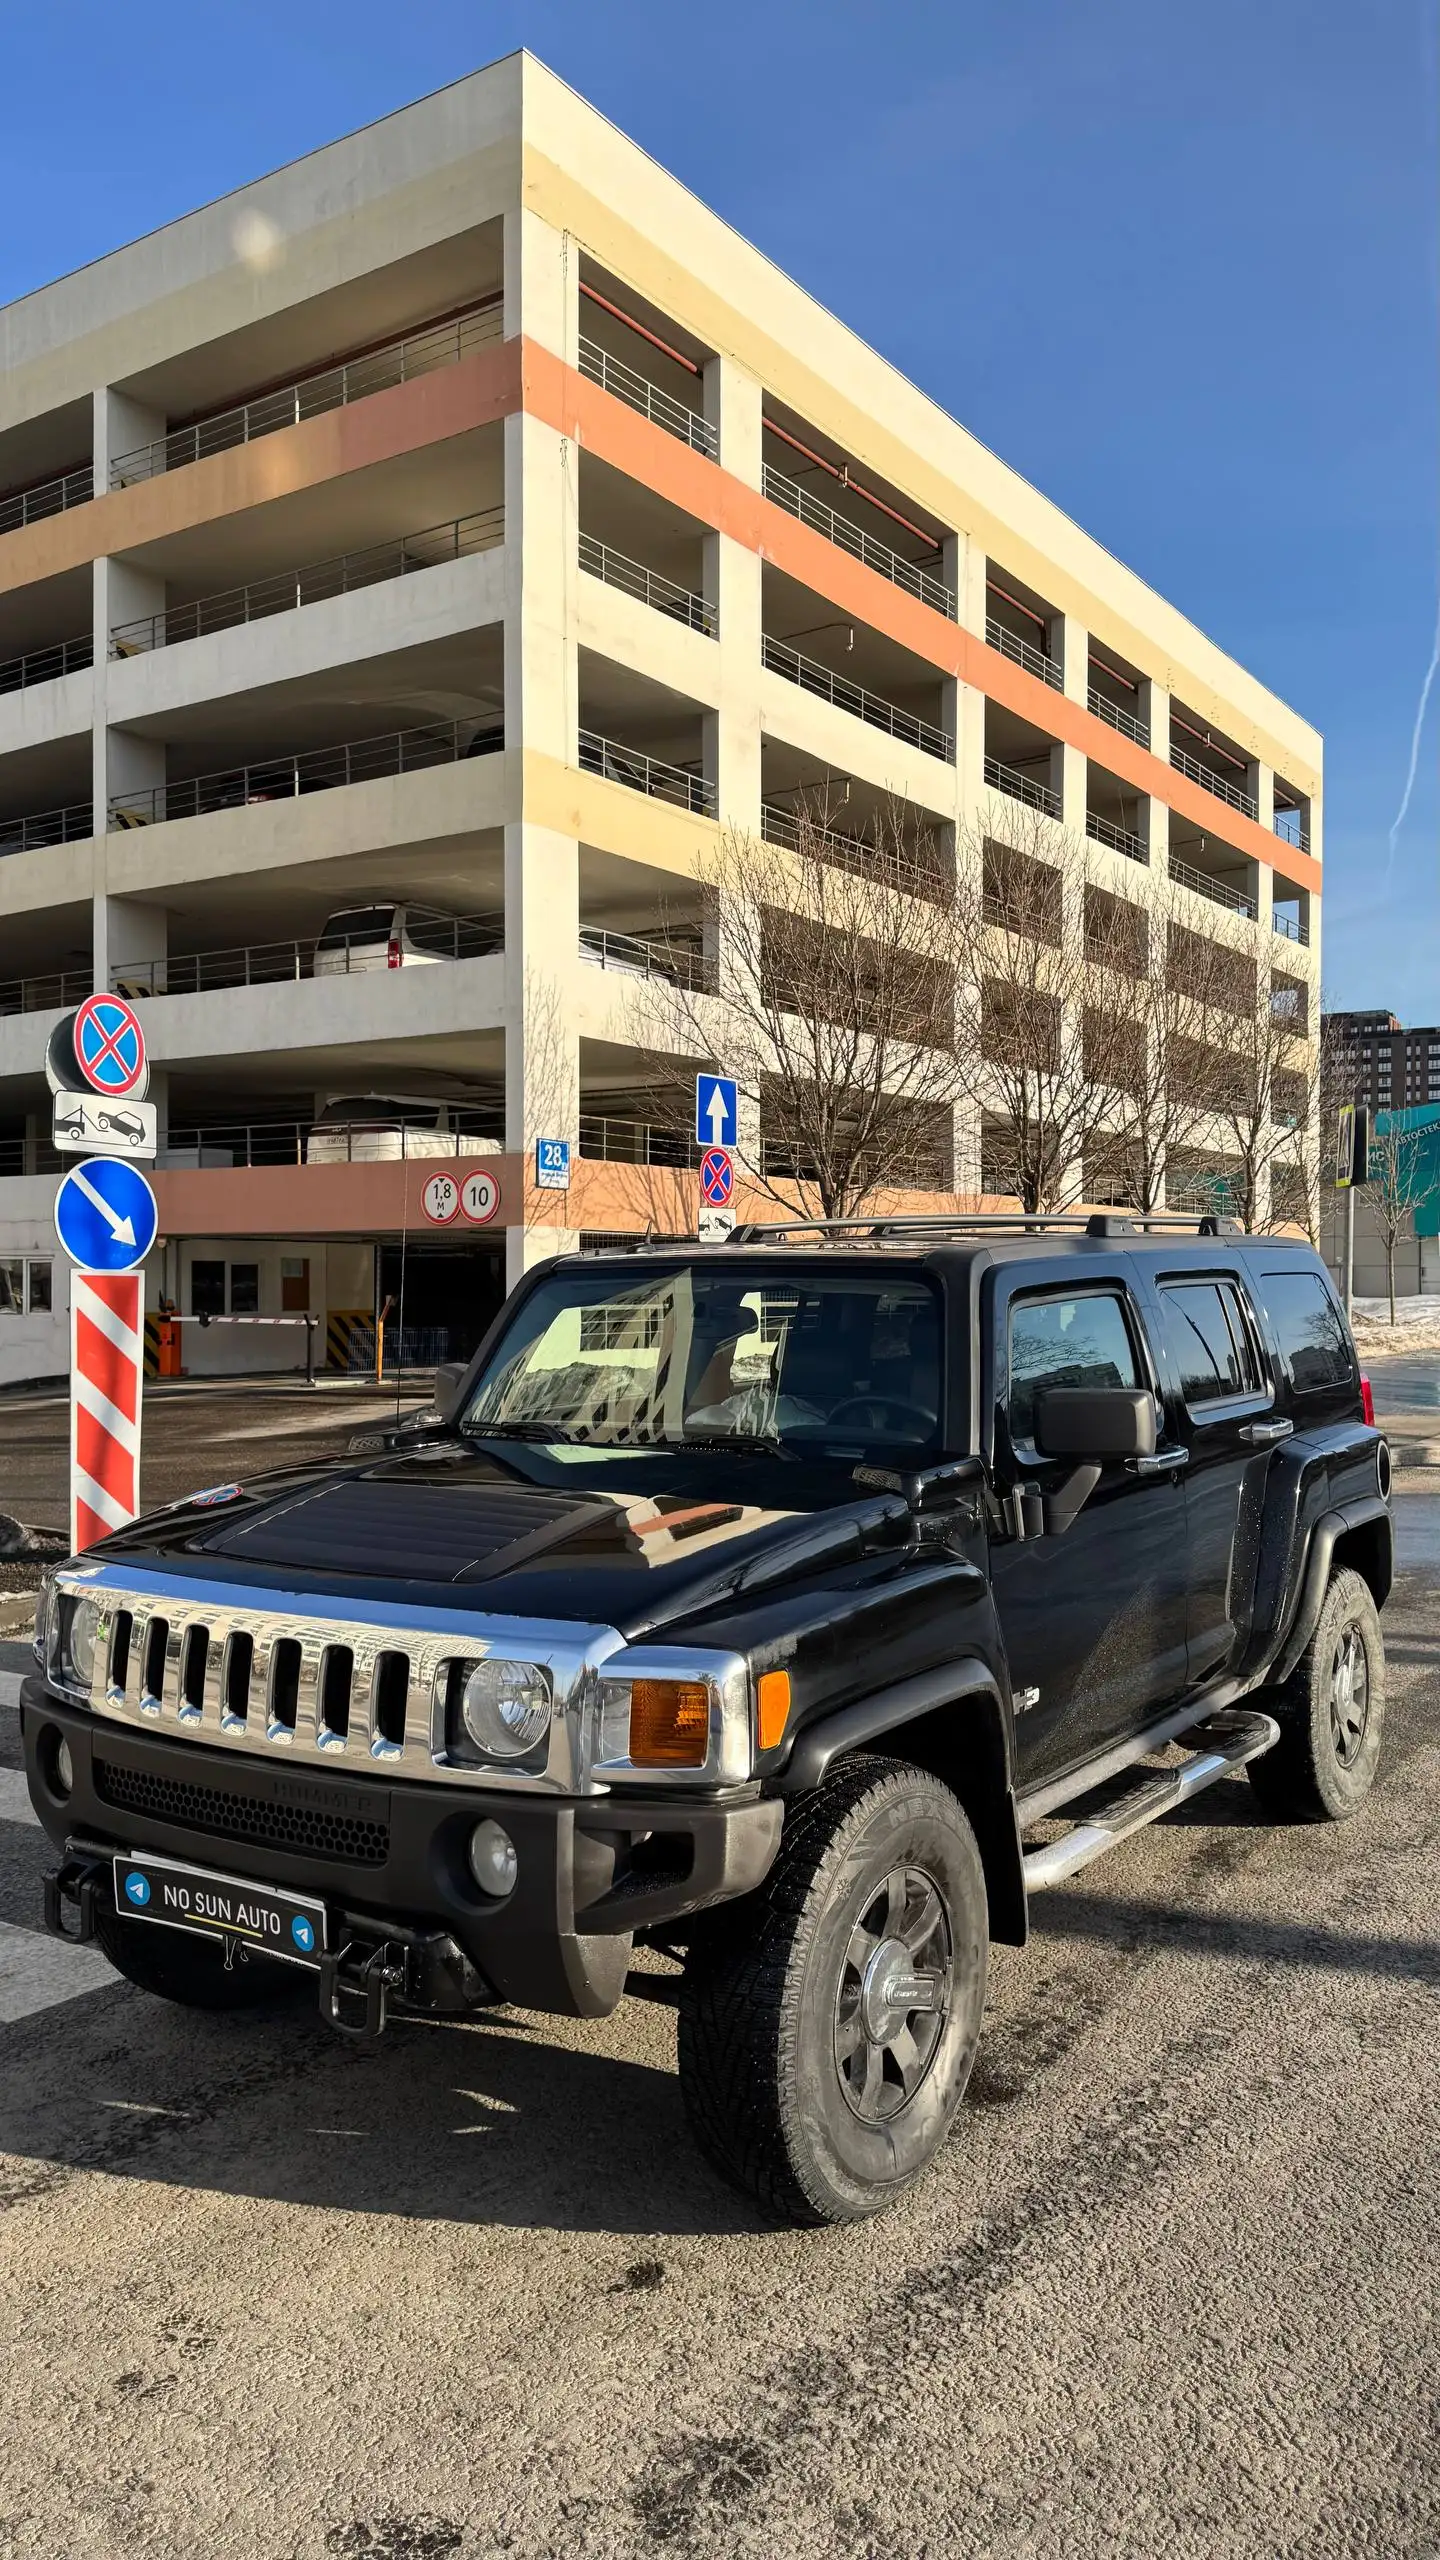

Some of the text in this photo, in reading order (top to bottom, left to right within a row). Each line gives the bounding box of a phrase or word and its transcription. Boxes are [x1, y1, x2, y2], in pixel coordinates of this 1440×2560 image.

[1395, 1121, 1440, 1145] АВТОСТЕК
[544, 1144, 562, 1167] 28
[433, 1183, 451, 1201] 1,8
[470, 1186, 489, 1206] 10
[1013, 1686, 1040, 1716] H3
[164, 1884, 281, 1935] NO SUN AUTO
